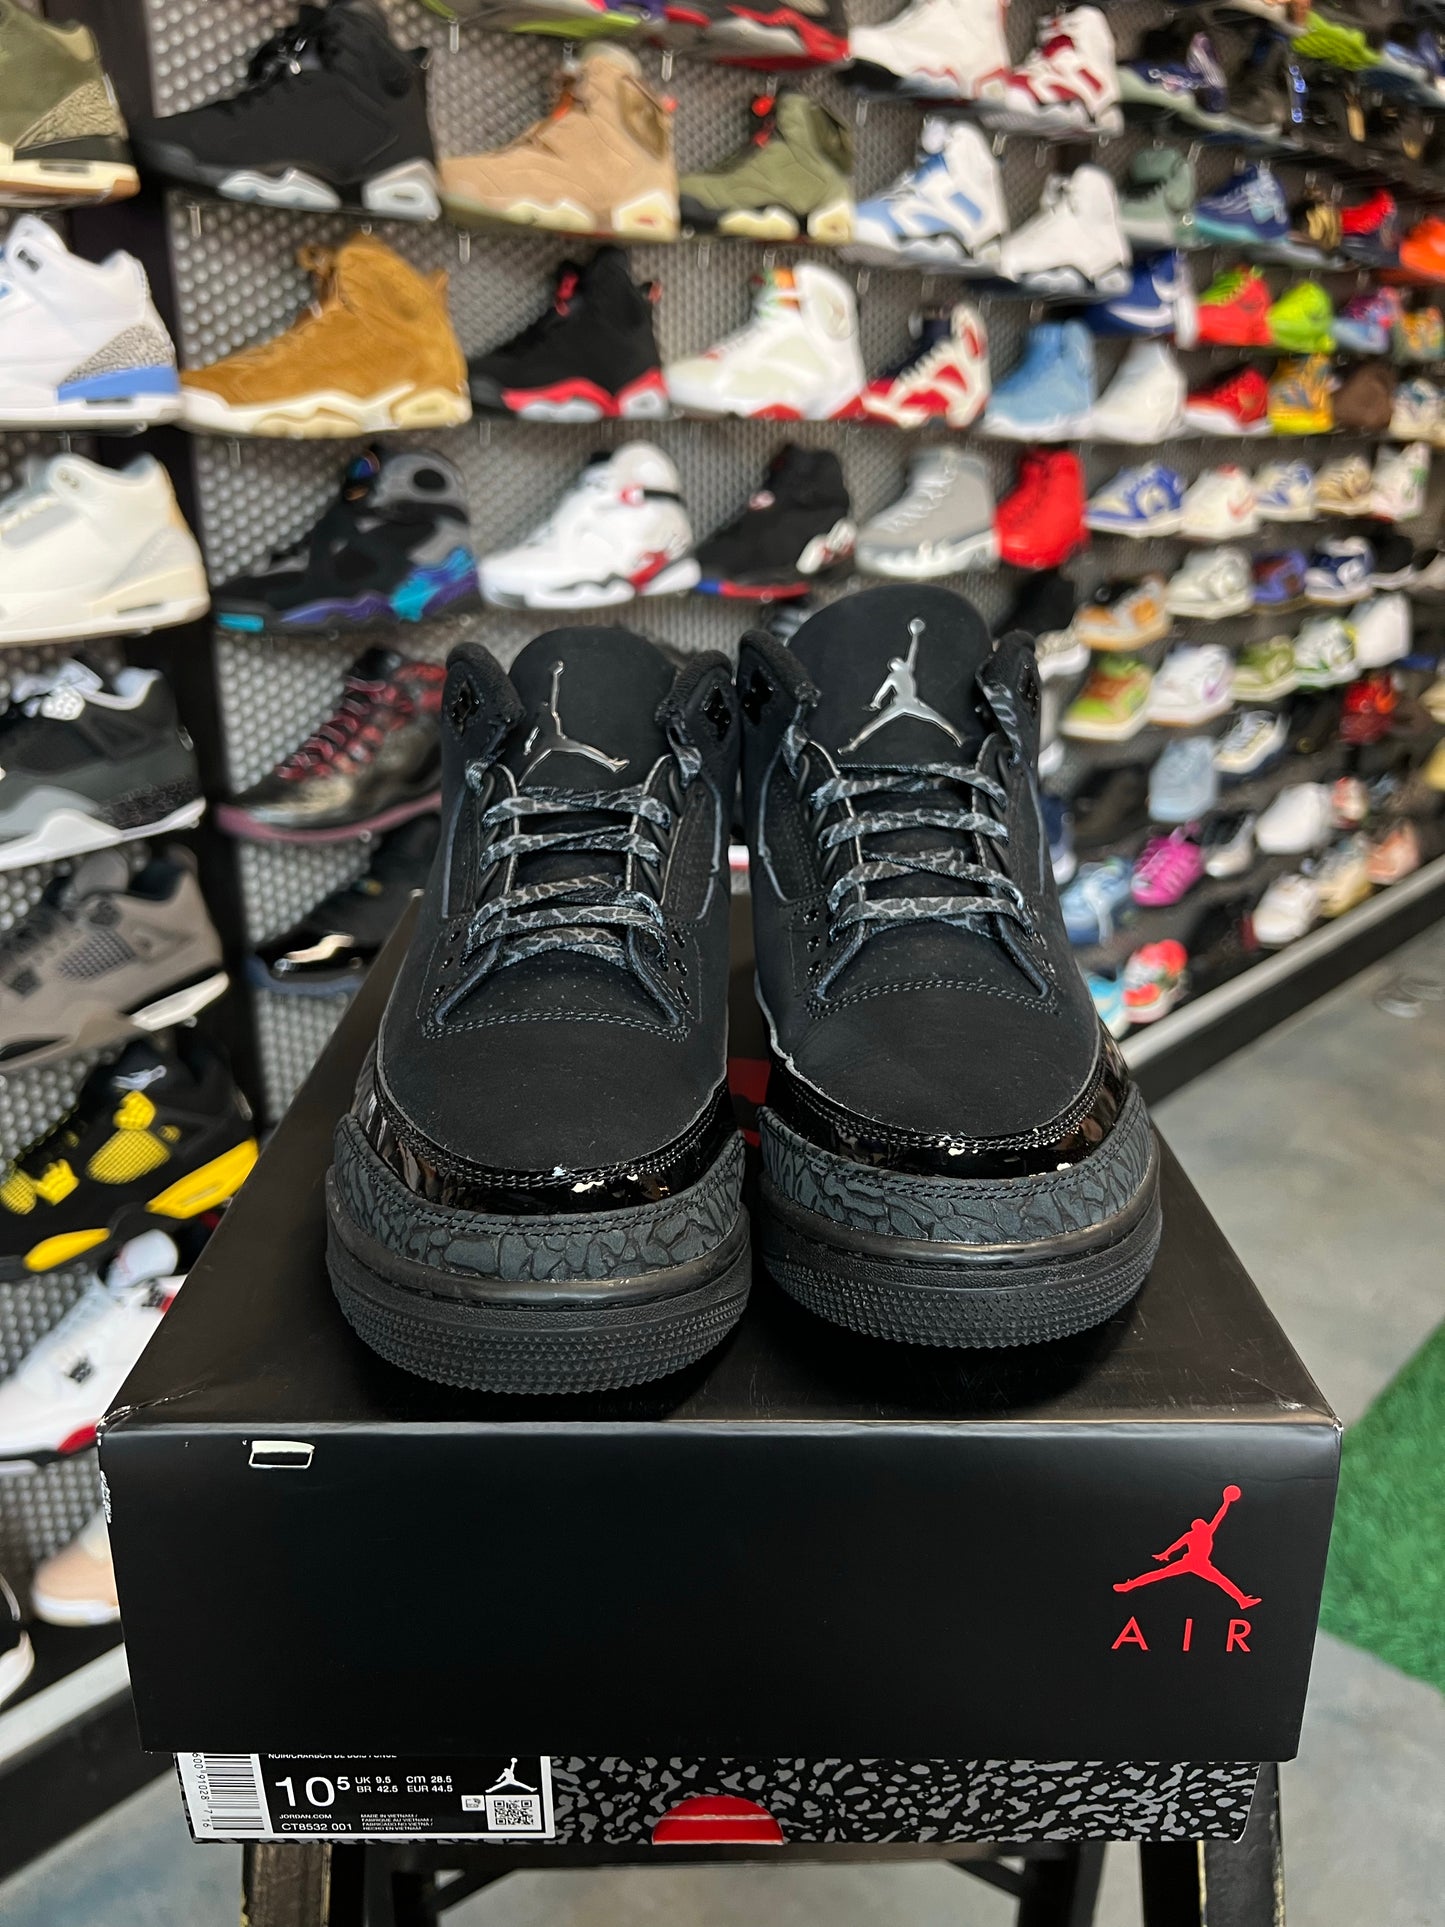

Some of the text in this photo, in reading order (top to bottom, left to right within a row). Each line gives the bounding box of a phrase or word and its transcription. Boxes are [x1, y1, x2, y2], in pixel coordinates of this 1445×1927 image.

[1111, 1616, 1252, 1652] AIR
[355, 1776, 391, 1784] UK 9.5
[430, 1775, 452, 1784] 28.5
[356, 1785, 399, 1793] BR 42.5
[407, 1785, 453, 1793] EUR 44.5
[281, 1823, 352, 1831] CT8532 001
